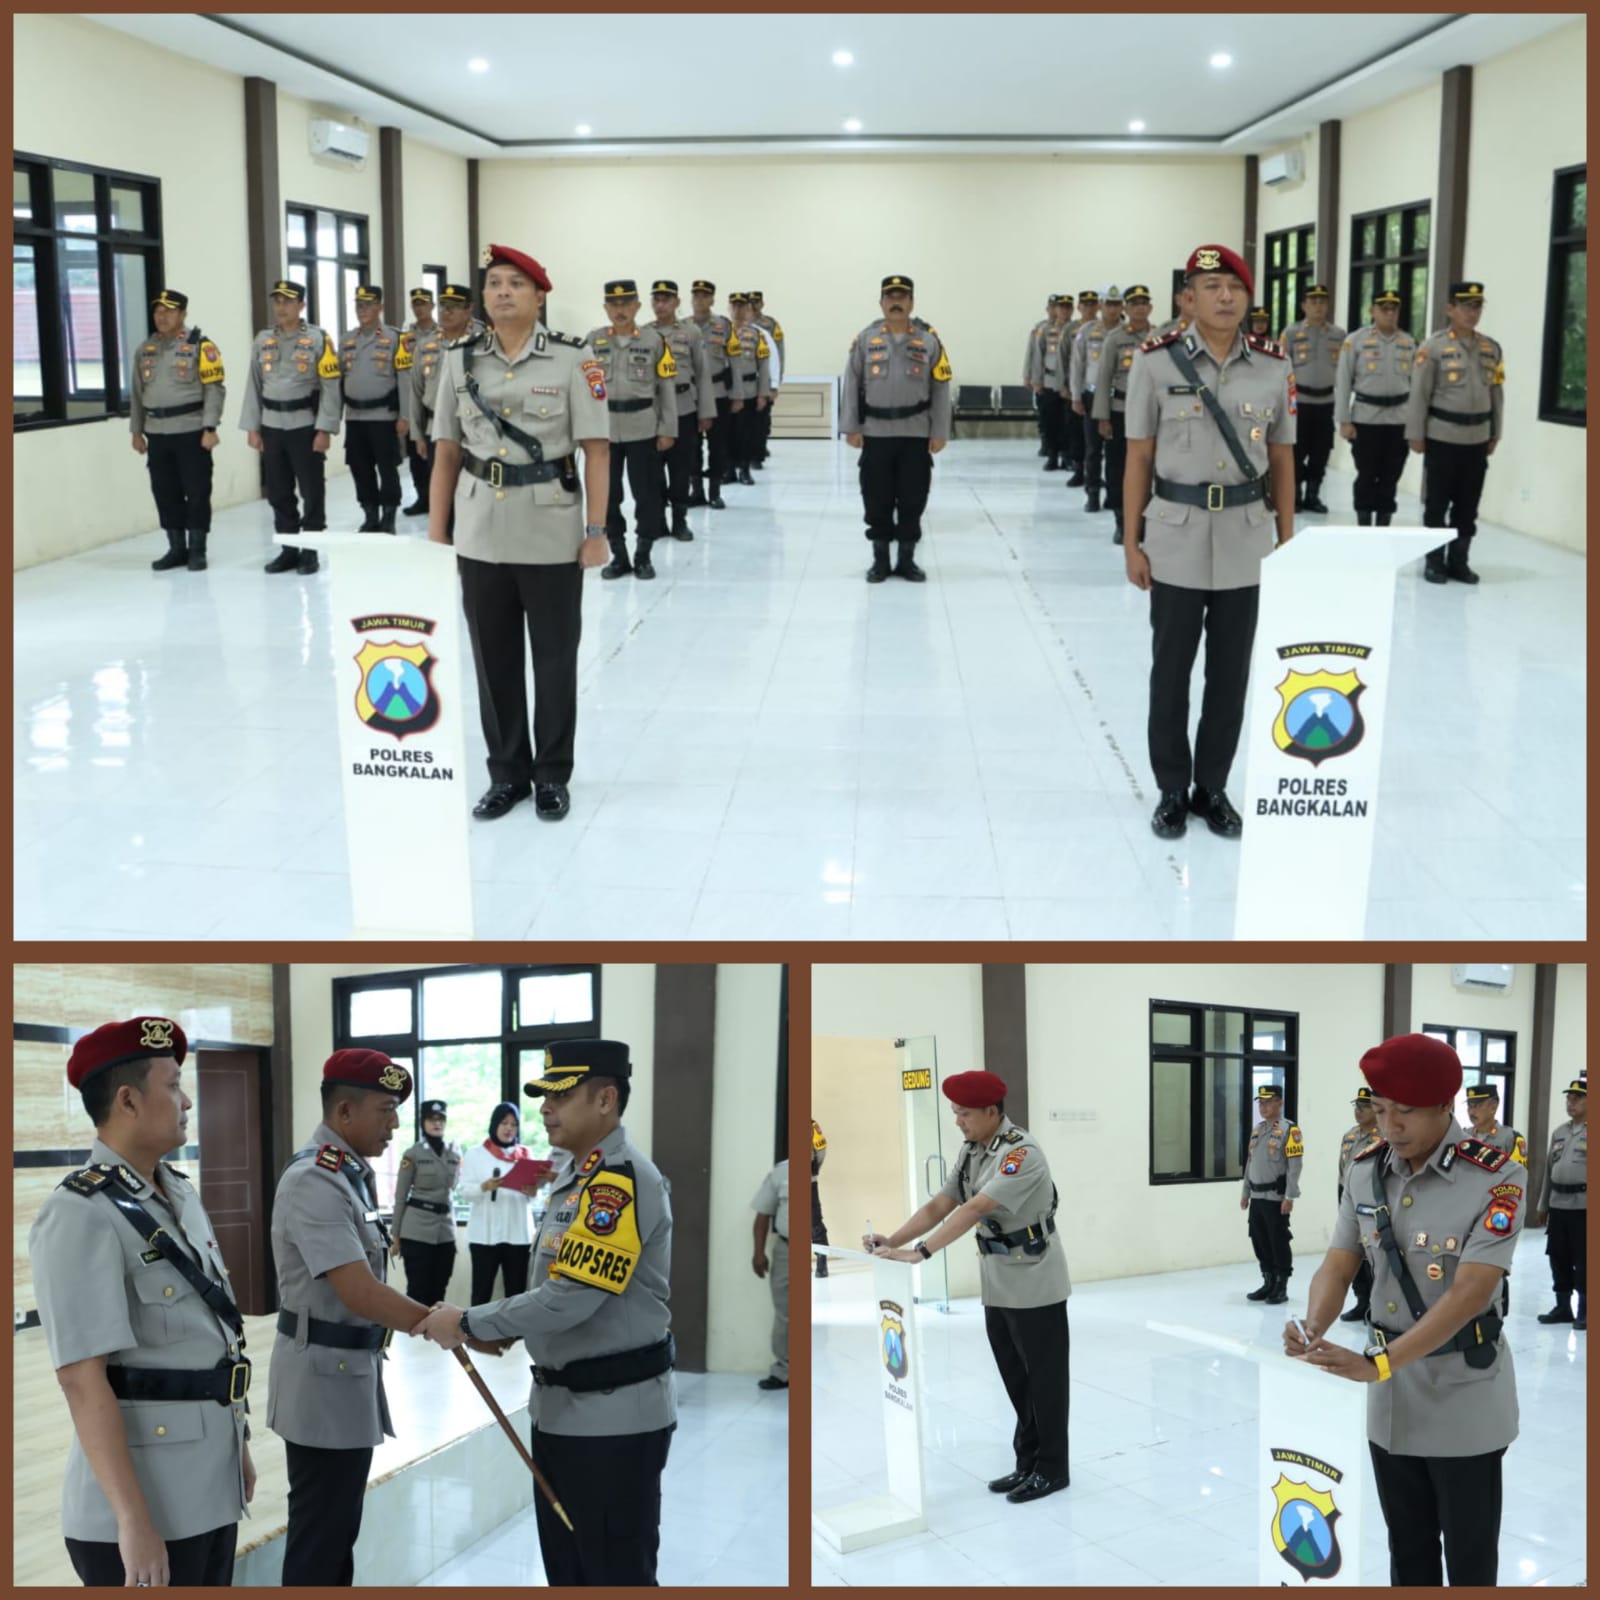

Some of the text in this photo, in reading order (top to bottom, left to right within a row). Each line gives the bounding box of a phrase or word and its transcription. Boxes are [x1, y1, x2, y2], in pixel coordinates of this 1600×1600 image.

[360, 617, 426, 630] JAWA TIMUR
[1283, 645, 1365, 657] JAWA TIMUR
[369, 748, 434, 763] POLRES
[352, 763, 454, 781] BANGKALAN
[1277, 777, 1348, 796] POLRES
[1256, 798, 1368, 817] BANGKALAN
[903, 1070, 931, 1089] GEDUNG
[558, 1237, 632, 1284] KAOPSRES
[1275, 1451, 1338, 1479] JAWA TIMUR
